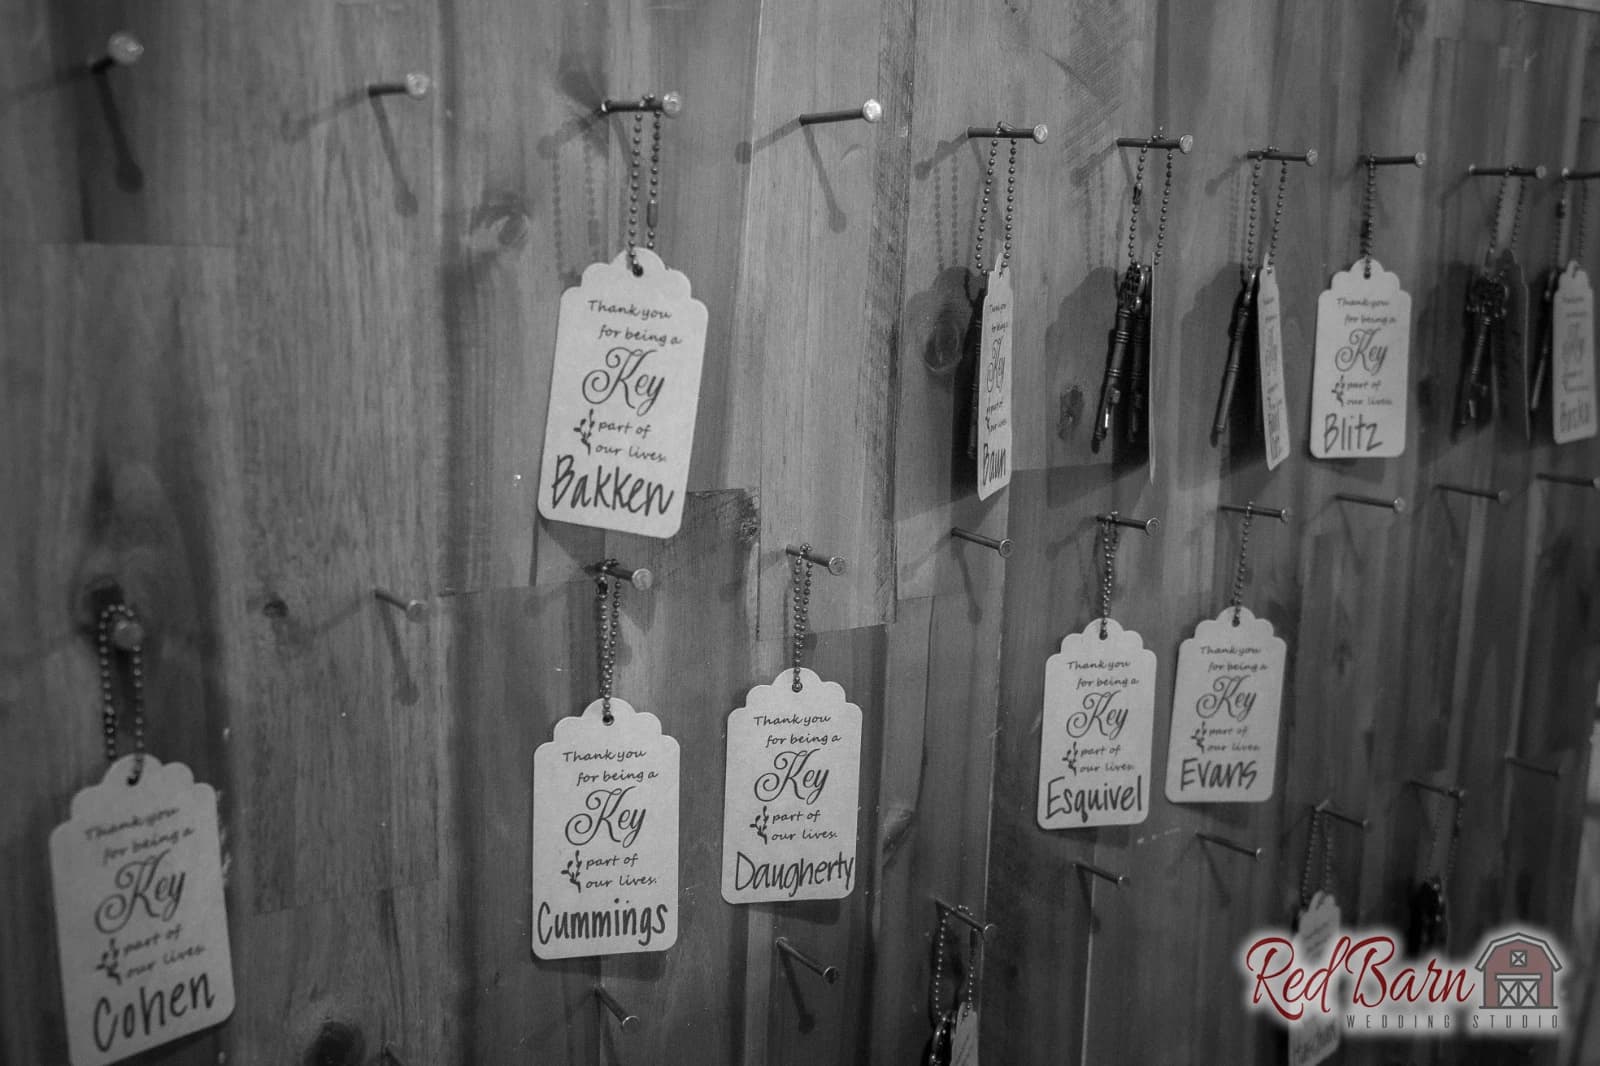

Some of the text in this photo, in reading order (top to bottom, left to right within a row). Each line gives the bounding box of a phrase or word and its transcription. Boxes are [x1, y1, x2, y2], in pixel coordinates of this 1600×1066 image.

[588, 300, 672, 320] Thank you
[599, 325, 682, 347] for being a
[1335, 328, 1389, 376] Key
[987, 335, 1005, 393] Key
[582, 346, 665, 416] Key
[598, 421, 651, 439] part of
[1324, 413, 1383, 454] Blitz
[596, 444, 622, 455] our
[552, 454, 674, 516] Bakken
[1200, 646, 1262, 656] Thank you
[1067, 660, 1131, 671] Thank you
[1208, 662, 1226, 673] for
[1227, 662, 1258, 672] being
[1076, 678, 1094, 690] for
[1096, 678, 1128, 688] being
[1195, 675, 1257, 722] Key
[753, 714, 832, 727] Thank you
[1066, 690, 1129, 740] Key
[766, 735, 787, 748] for
[790, 733, 829, 744] being
[1208, 726, 1248, 737] part of
[562, 749, 647, 763] Thank you
[1080, 745, 1122, 757] part of
[576, 770, 658, 787] for being a
[754, 749, 830, 805] Key
[1080, 765, 1102, 773] our
[1180, 757, 1257, 791] Evans
[1045, 774, 1142, 823] Esquivel
[85, 807, 180, 840] Thank you
[565, 786, 646, 848] Key
[772, 809, 821, 824] part of
[771, 829, 838, 840] our lives.
[103, 828, 195, 866] for being a
[586, 853, 638, 870] part of
[586, 875, 657, 889] our lives.
[735, 851, 854, 897] Daugherty
[94, 849, 186, 934] Key
[537, 898, 668, 946] Cummings
[123, 924, 183, 956] part of
[126, 962, 156, 978] our
[93, 973, 215, 1052] Cohen
